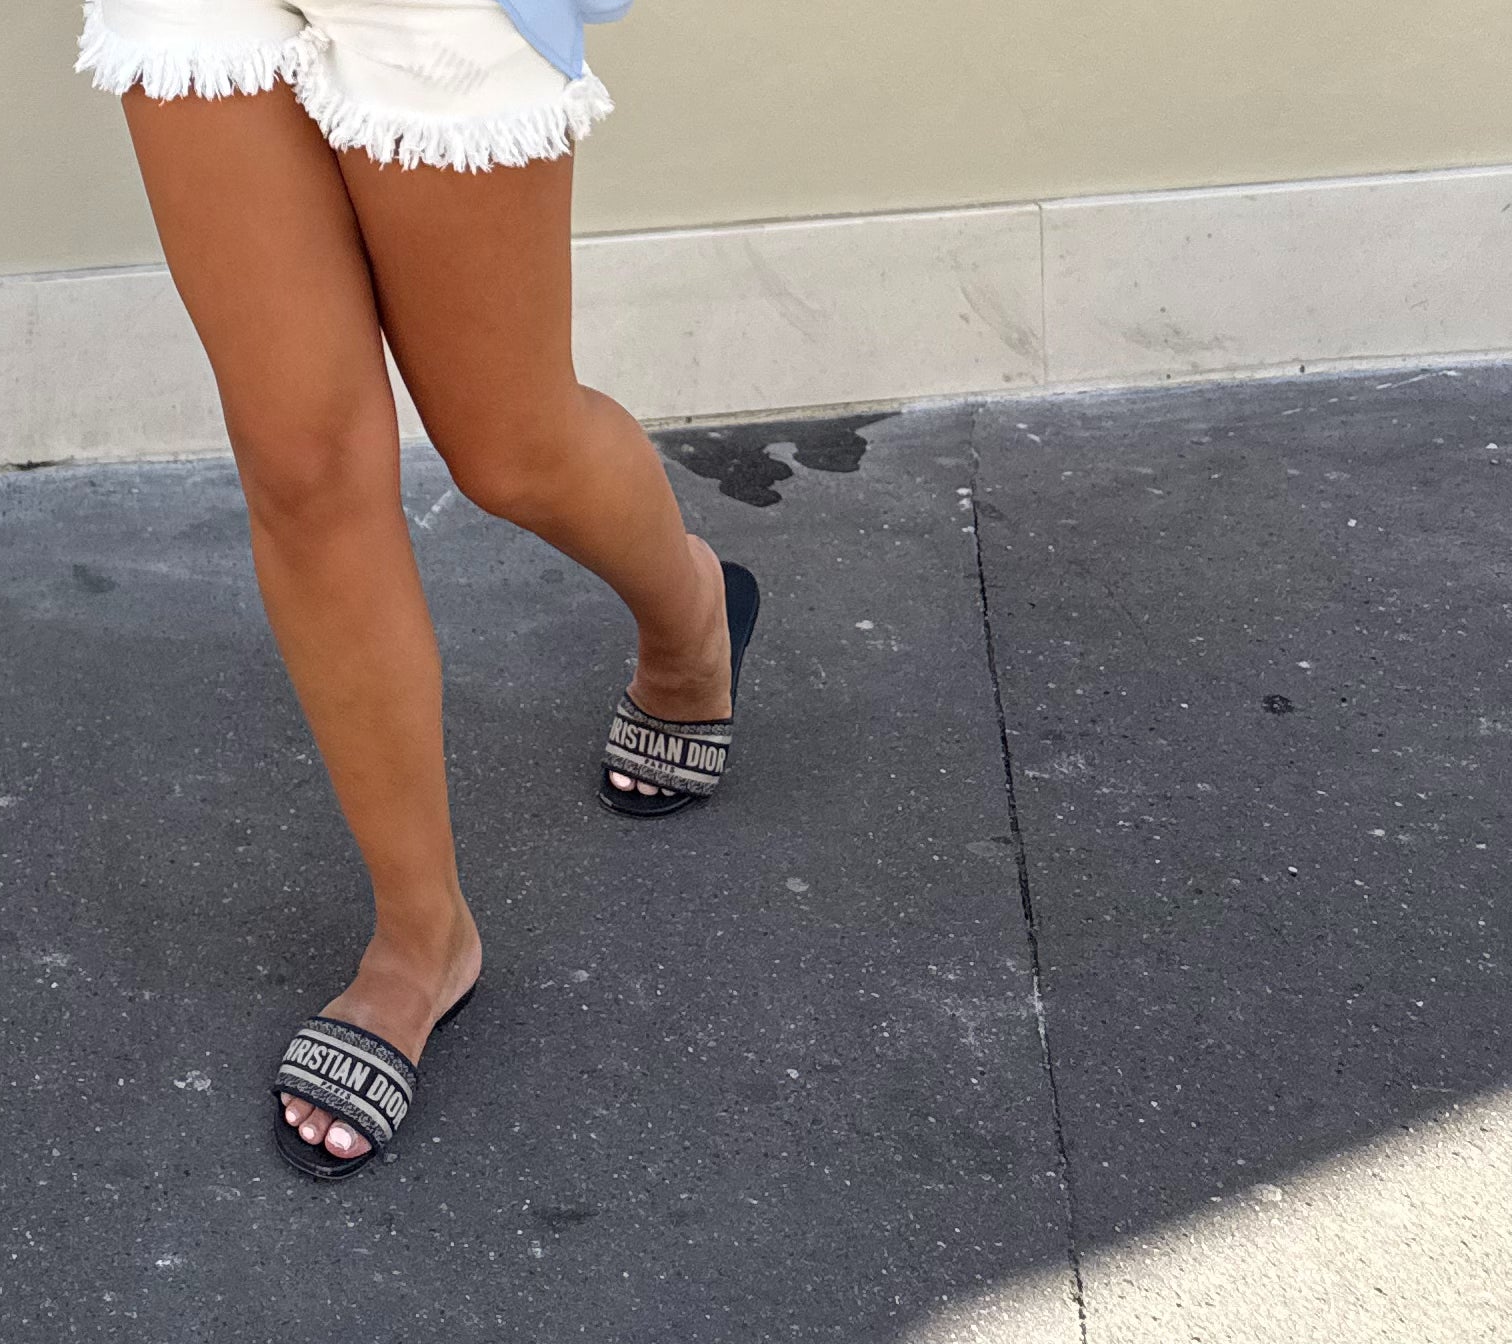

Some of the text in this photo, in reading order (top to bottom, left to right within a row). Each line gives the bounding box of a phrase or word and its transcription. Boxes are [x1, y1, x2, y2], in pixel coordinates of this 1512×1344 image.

[609, 716, 726, 773] RISTIAN DIOR
[282, 1038, 408, 1130] HRISTIAN DIOR
